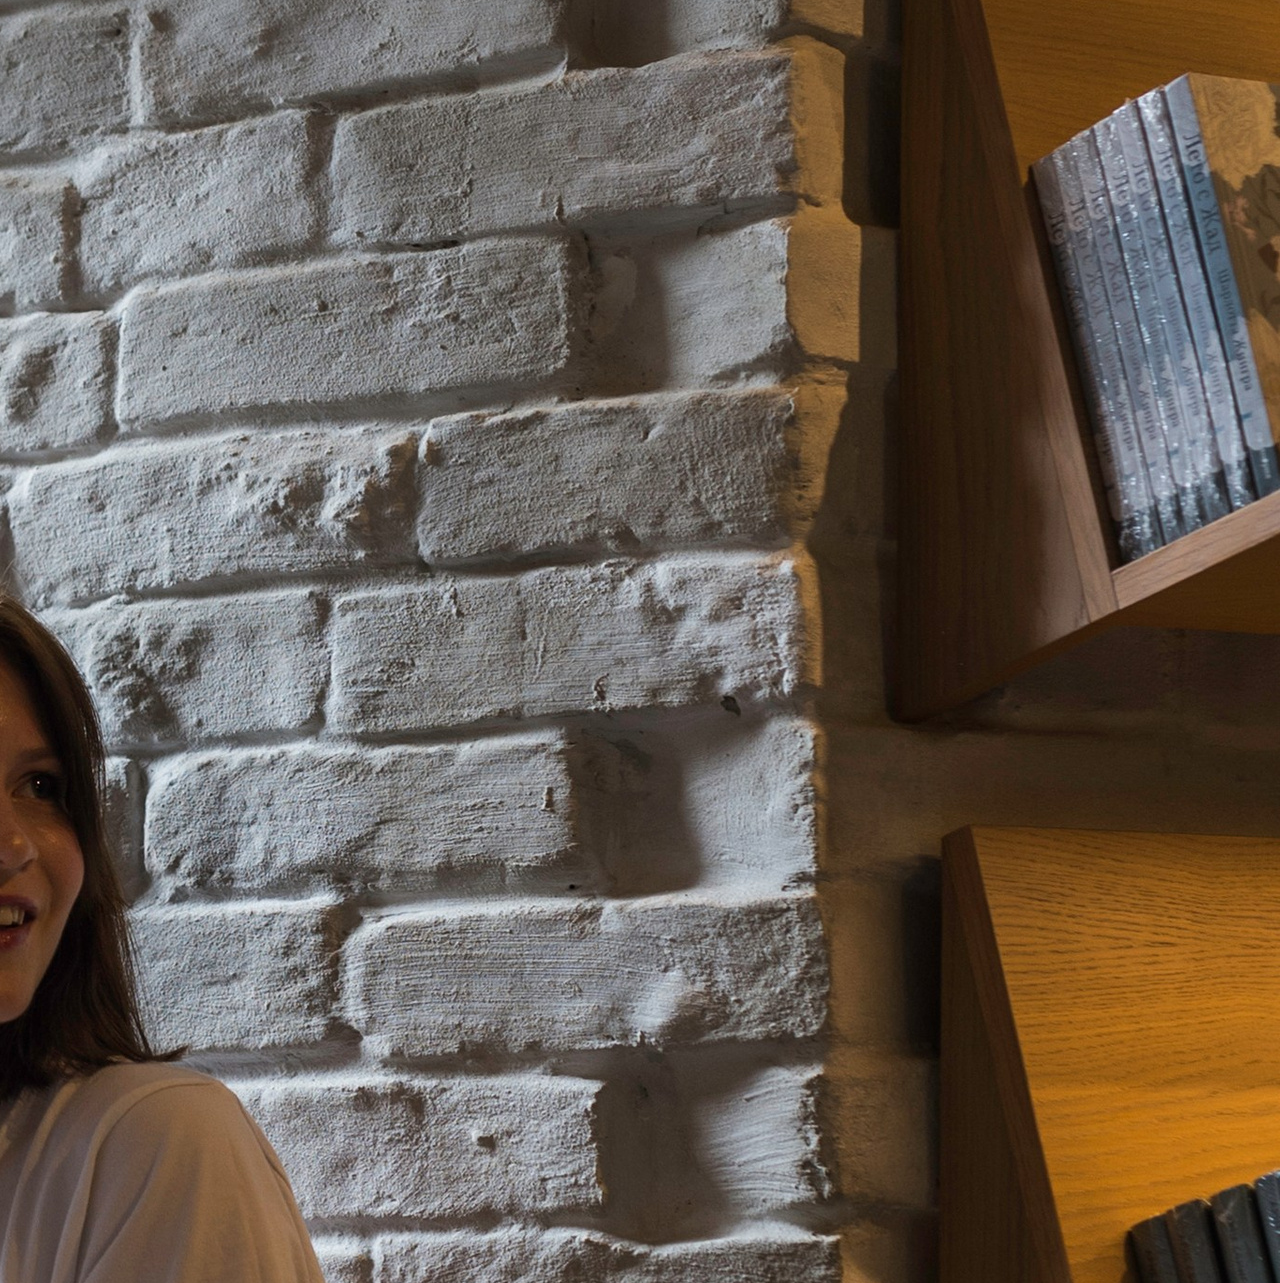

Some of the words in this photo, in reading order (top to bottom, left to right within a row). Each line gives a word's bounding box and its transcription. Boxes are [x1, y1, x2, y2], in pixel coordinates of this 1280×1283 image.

[1069, 198, 1091, 249] Лето
[1091, 187, 1112, 237] Лето
[1105, 258, 1127, 305] Жад
[1133, 160, 1155, 212] Лето
[1149, 234, 1169, 281] Жад
[1184, 132, 1207, 184] Лето
[1200, 206, 1223, 254] Жад
[1217, 268, 1240, 334] Шарлотта
